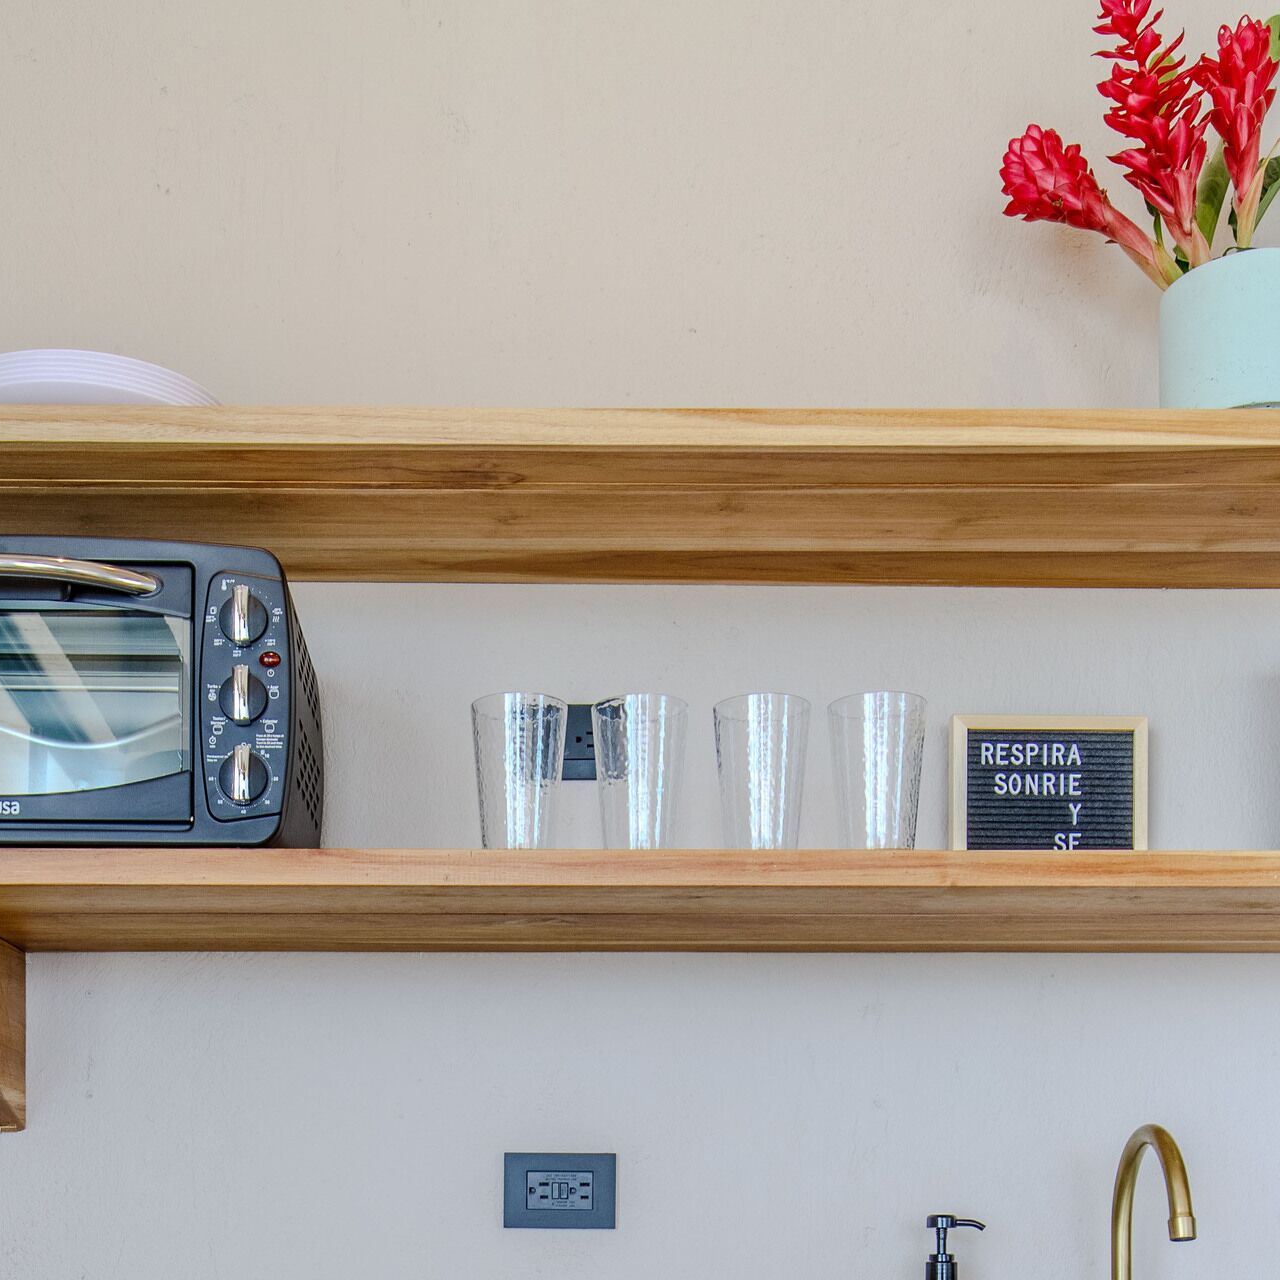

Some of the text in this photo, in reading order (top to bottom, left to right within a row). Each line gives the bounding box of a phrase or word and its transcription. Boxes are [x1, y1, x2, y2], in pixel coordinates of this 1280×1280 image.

[981, 743, 1081, 766] RESPIRA
[994, 773, 1082, 796] SONRIE
[1069, 803, 1082, 826] Y
